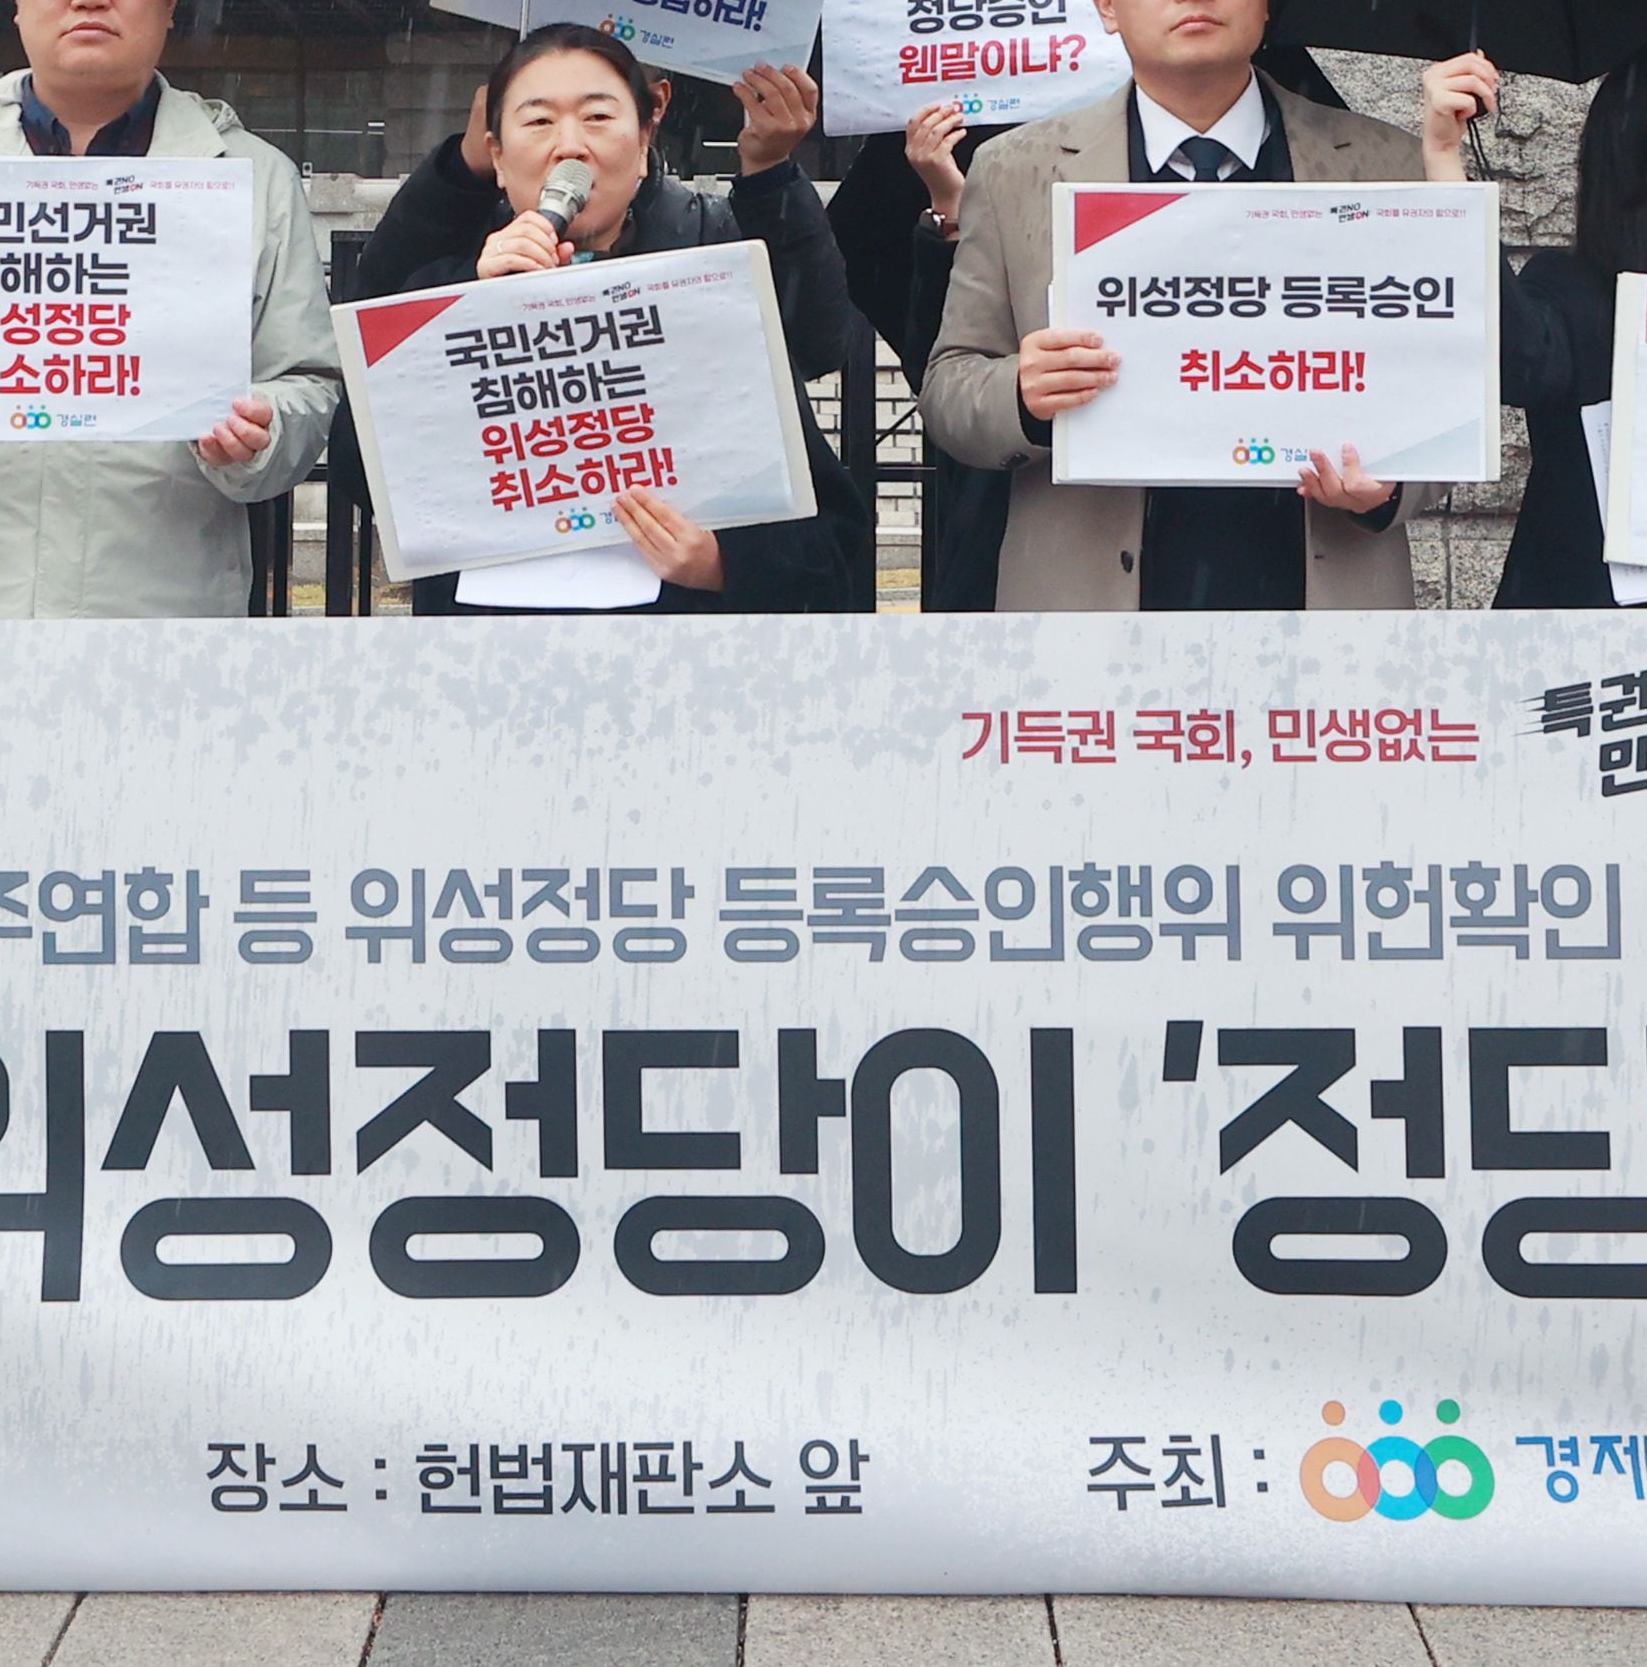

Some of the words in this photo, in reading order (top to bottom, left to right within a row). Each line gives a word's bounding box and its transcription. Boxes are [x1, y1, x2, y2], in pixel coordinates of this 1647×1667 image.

[898, 35, 1086, 85] 웬말이냐?
[1096, 276, 1272, 318] 위성정당
[1281, 275, 1455, 319] 등록승인
[445, 304, 665, 369] 국민선거권
[471, 359, 646, 419] 침해하는
[1179, 349, 1366, 393] 취소하라!
[482, 403, 655, 464] 위성정당
[490, 447, 678, 512] 취소하라!
[961, 710, 1117, 764] 기득권
[1132, 708, 1252, 769] 국회,
[1268, 708, 1480, 763] 민생없는
[233, 869, 318, 965] 등
[345, 867, 695, 964] 위성정당
[719, 862, 1242, 963] 등록승인행위
[1272, 861, 1622, 961] 위헌확인
[206, 1442, 348, 1513] 장소
[415, 1440, 776, 1516] 헌법재판소
[799, 1438, 870, 1515] 앞
